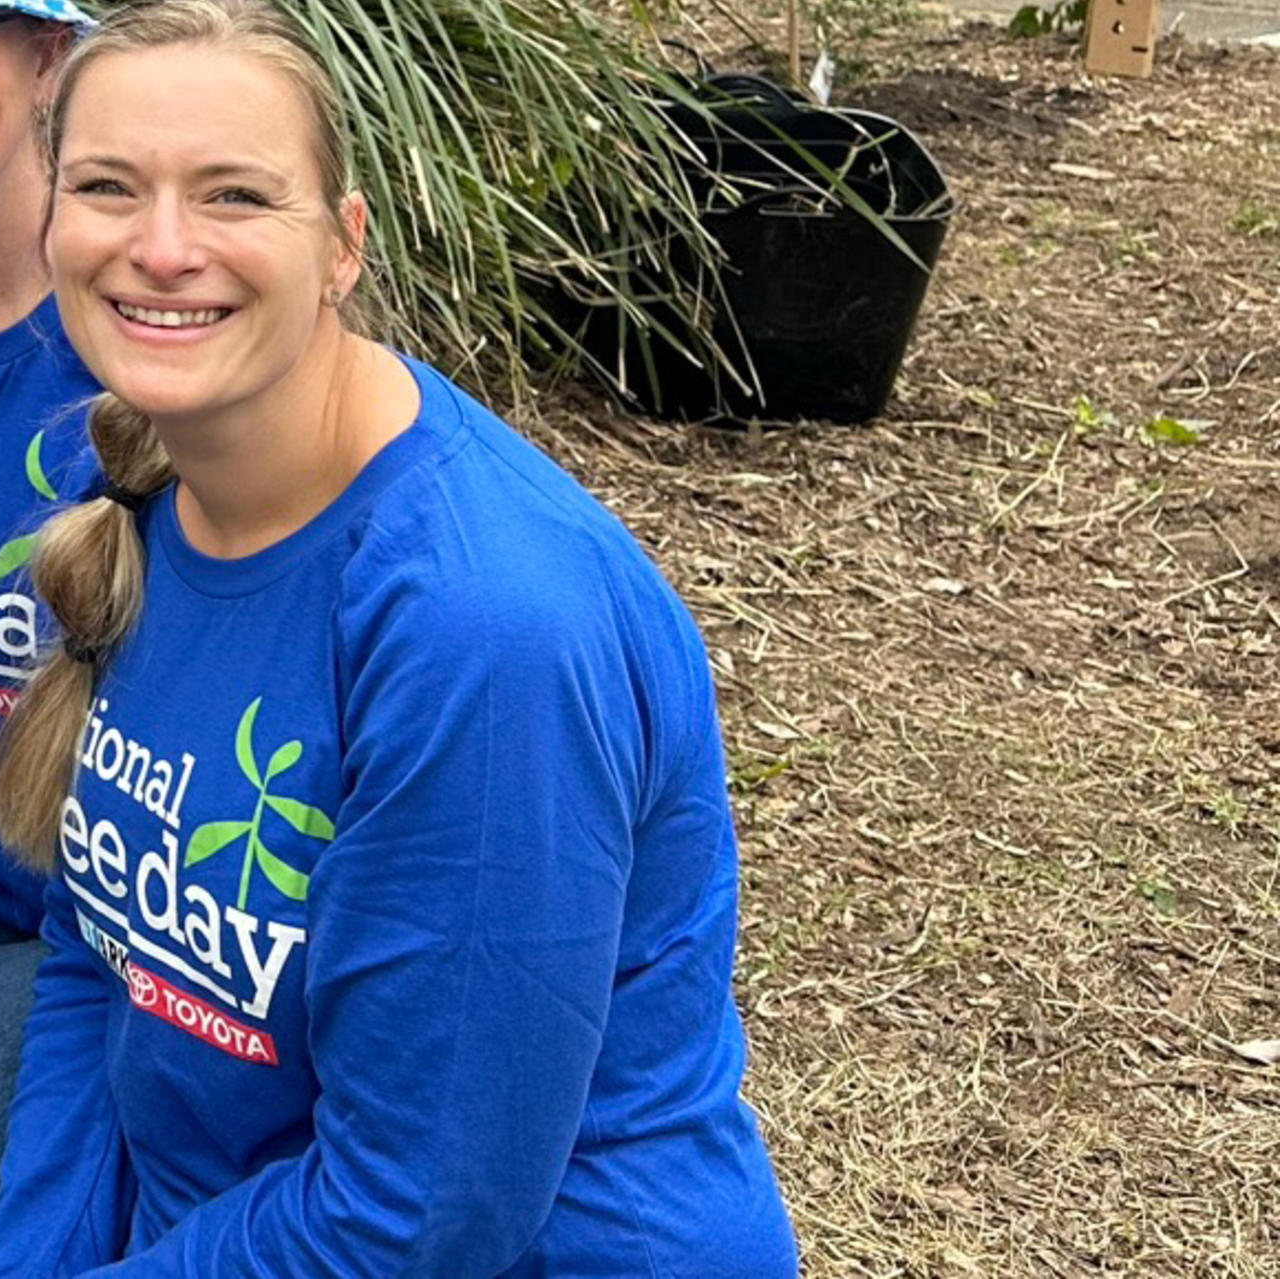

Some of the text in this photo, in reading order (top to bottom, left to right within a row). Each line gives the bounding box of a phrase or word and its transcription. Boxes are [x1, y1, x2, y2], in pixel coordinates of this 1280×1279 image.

[80, 697, 196, 830] ional
[60, 795, 307, 1020] ee day
[161, 988, 269, 1061] TOYOTA
